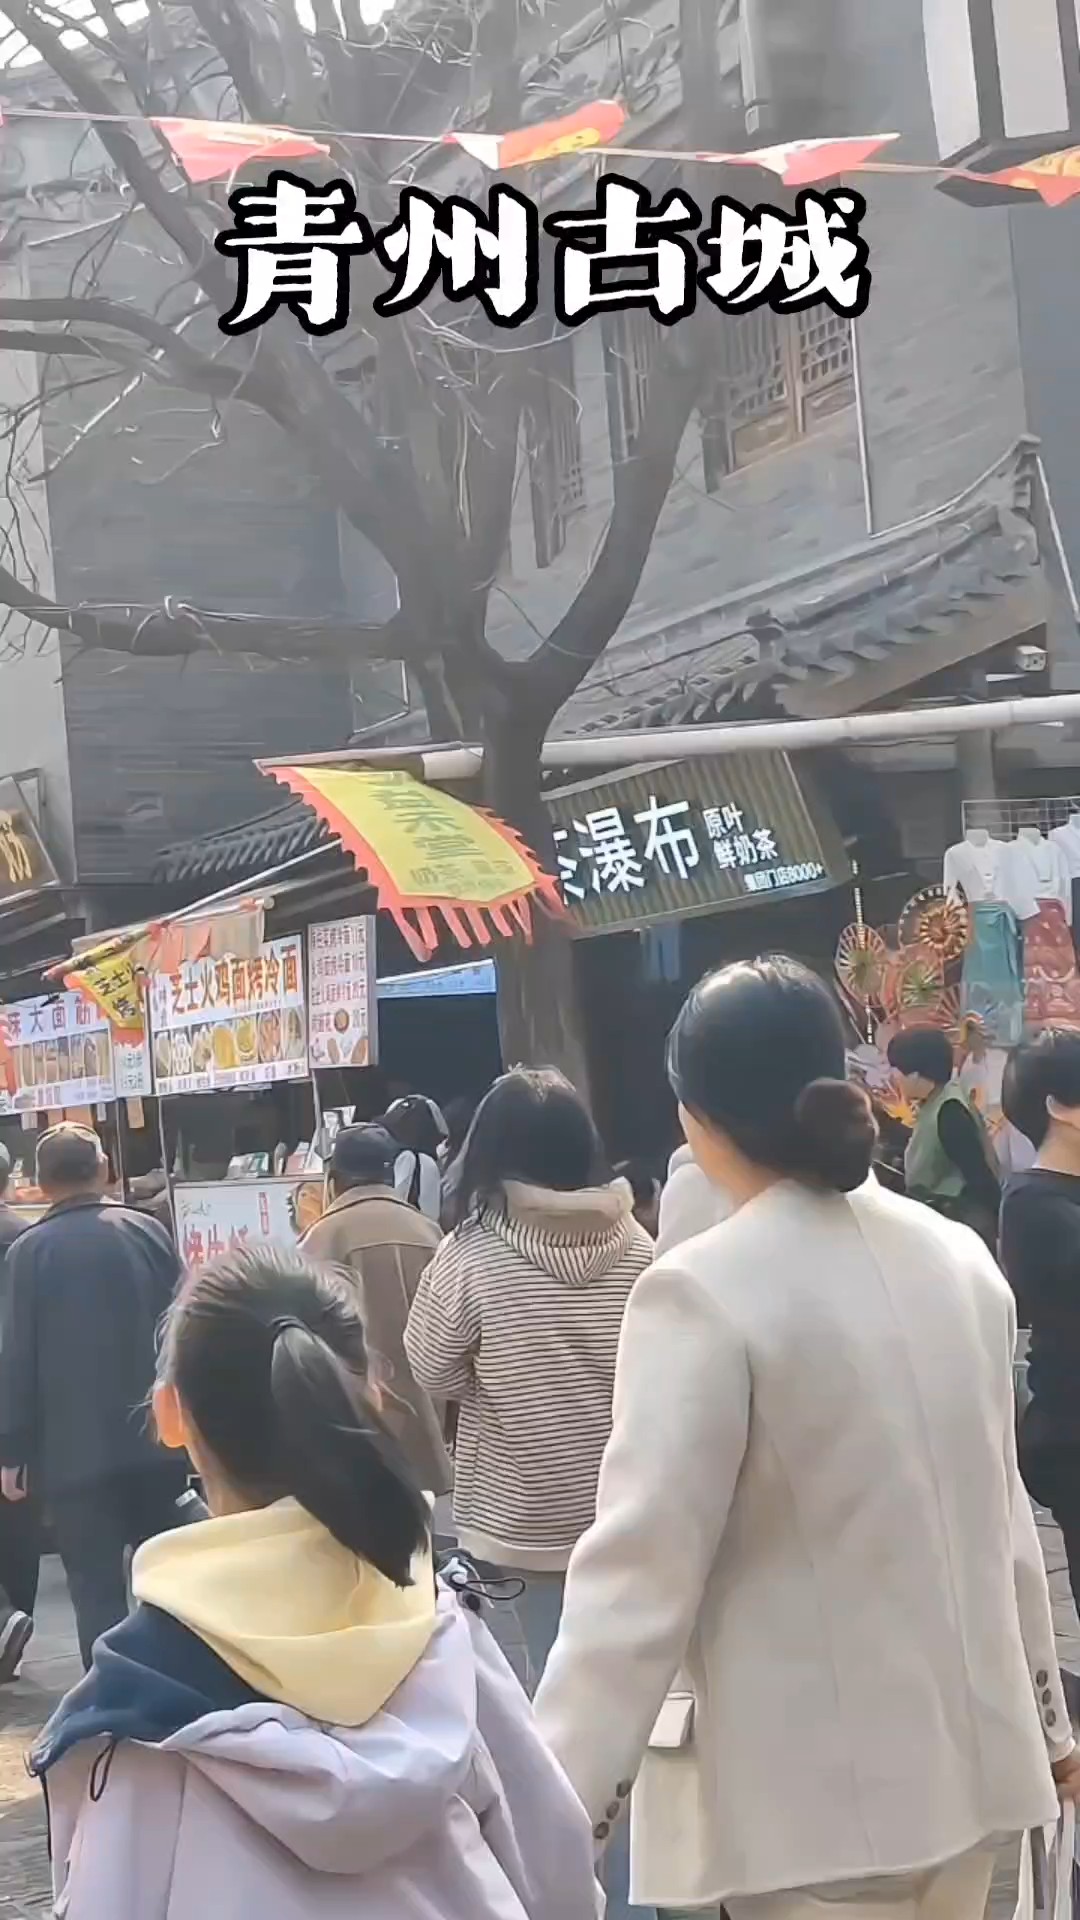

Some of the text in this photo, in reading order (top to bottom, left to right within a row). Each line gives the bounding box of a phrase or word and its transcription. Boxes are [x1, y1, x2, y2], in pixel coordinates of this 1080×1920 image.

[703, 802, 743, 839] 原叶
[713, 828, 779, 869] 鲜奶茶
